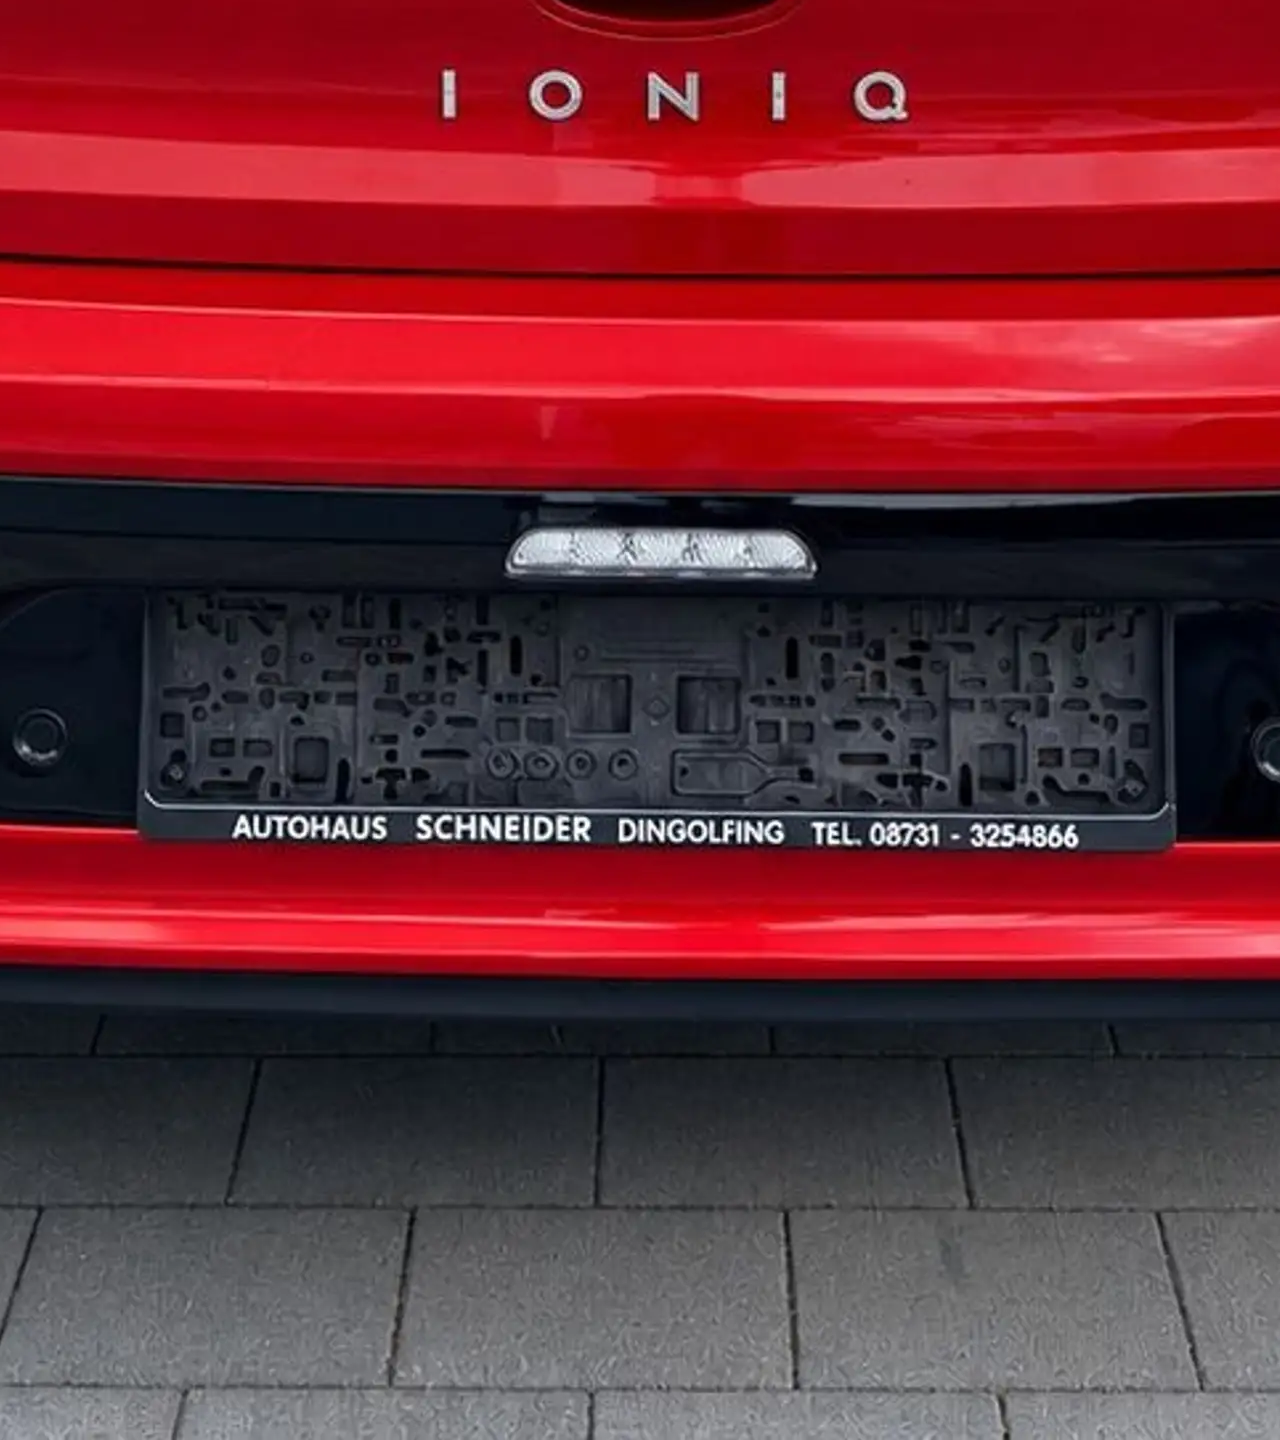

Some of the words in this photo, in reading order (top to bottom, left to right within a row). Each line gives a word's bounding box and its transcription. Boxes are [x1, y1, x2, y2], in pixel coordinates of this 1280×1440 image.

[440, 68, 908, 123] IONIQ
[231, 814, 388, 840] AUTOHAUS
[415, 814, 592, 842] SCHNEIDER
[618, 817, 786, 845] DINGOLFING
[811, 821, 862, 846] TEL.
[869, 822, 940, 847] 08731
[969, 822, 1080, 849] 3254866
